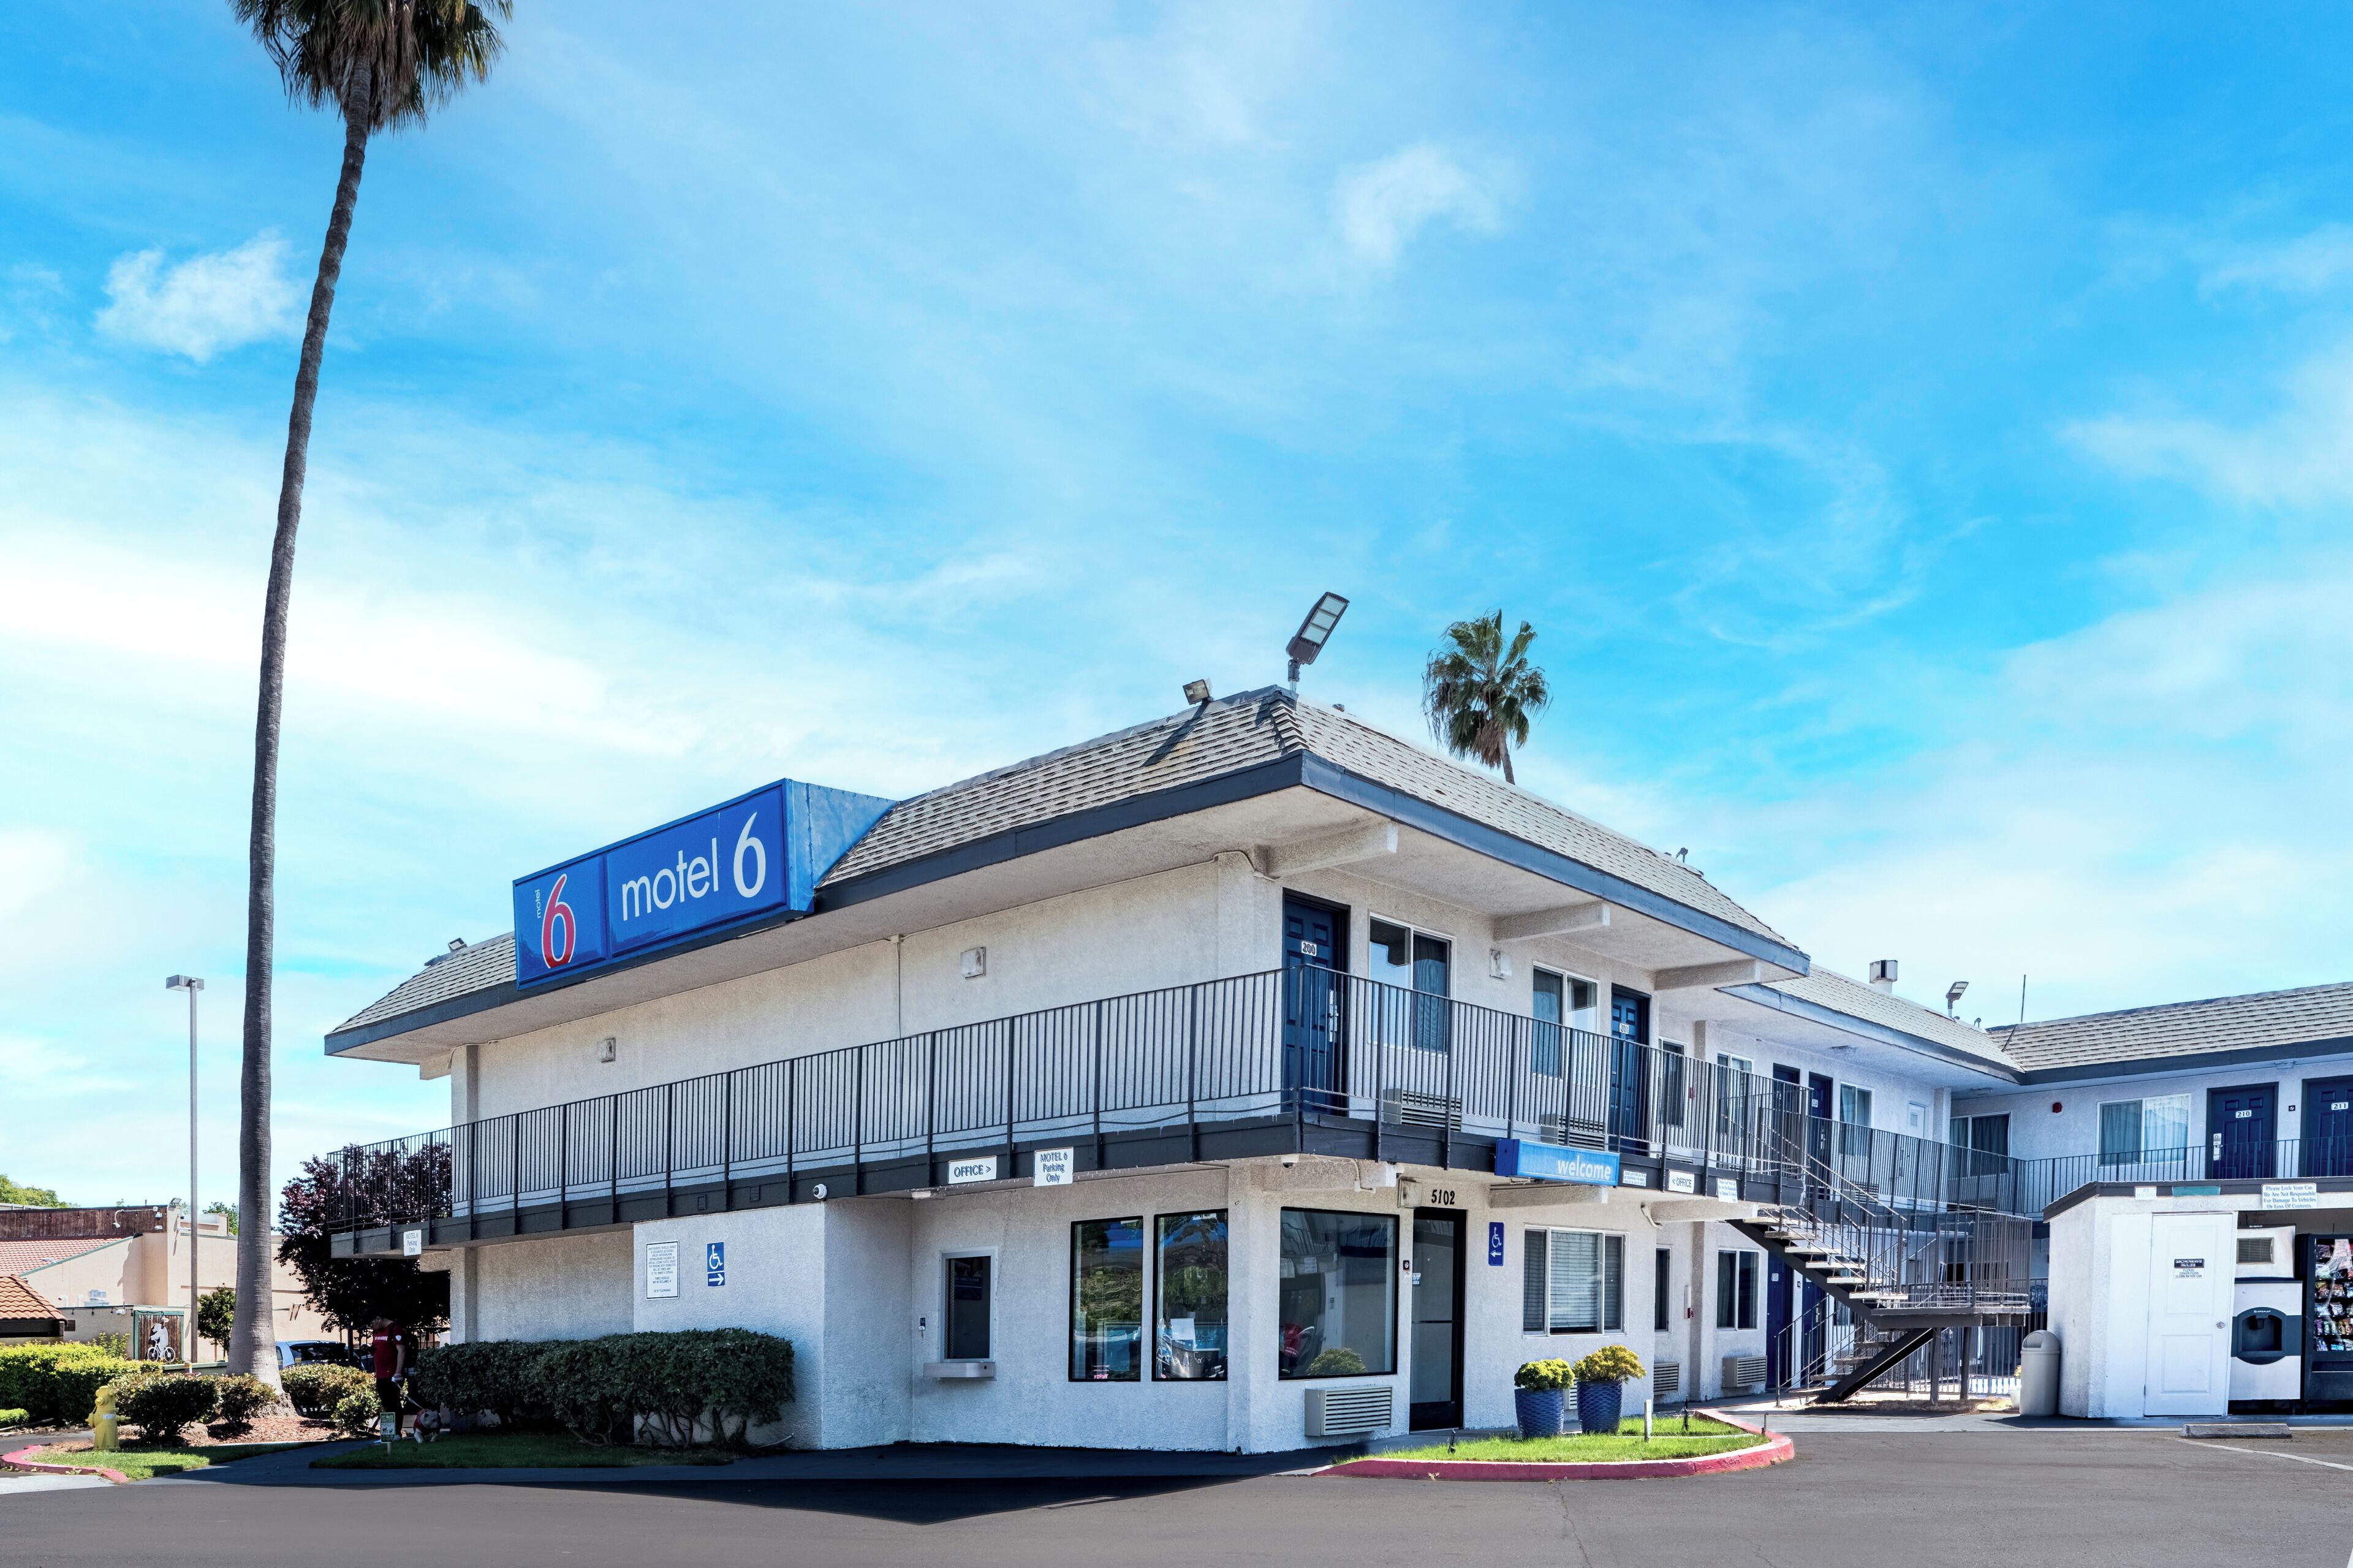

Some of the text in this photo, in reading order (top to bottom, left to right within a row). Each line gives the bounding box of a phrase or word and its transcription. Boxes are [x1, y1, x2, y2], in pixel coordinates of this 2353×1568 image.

[622, 811, 766, 921] motel 6
[541, 873, 576, 968] 6
[1303, 942, 1315, 955] 200
[1040, 1152, 1068, 1162] MOTEL 6
[954, 1165, 984, 1177] OFFICE
[1043, 1162, 1064, 1172] Parking
[1558, 1155, 1611, 1180] welcome
[1046, 1173, 1060, 1183] Only
[1676, 1177, 1692, 1187] OFFICE
[1431, 1189, 1455, 1205] 5102
